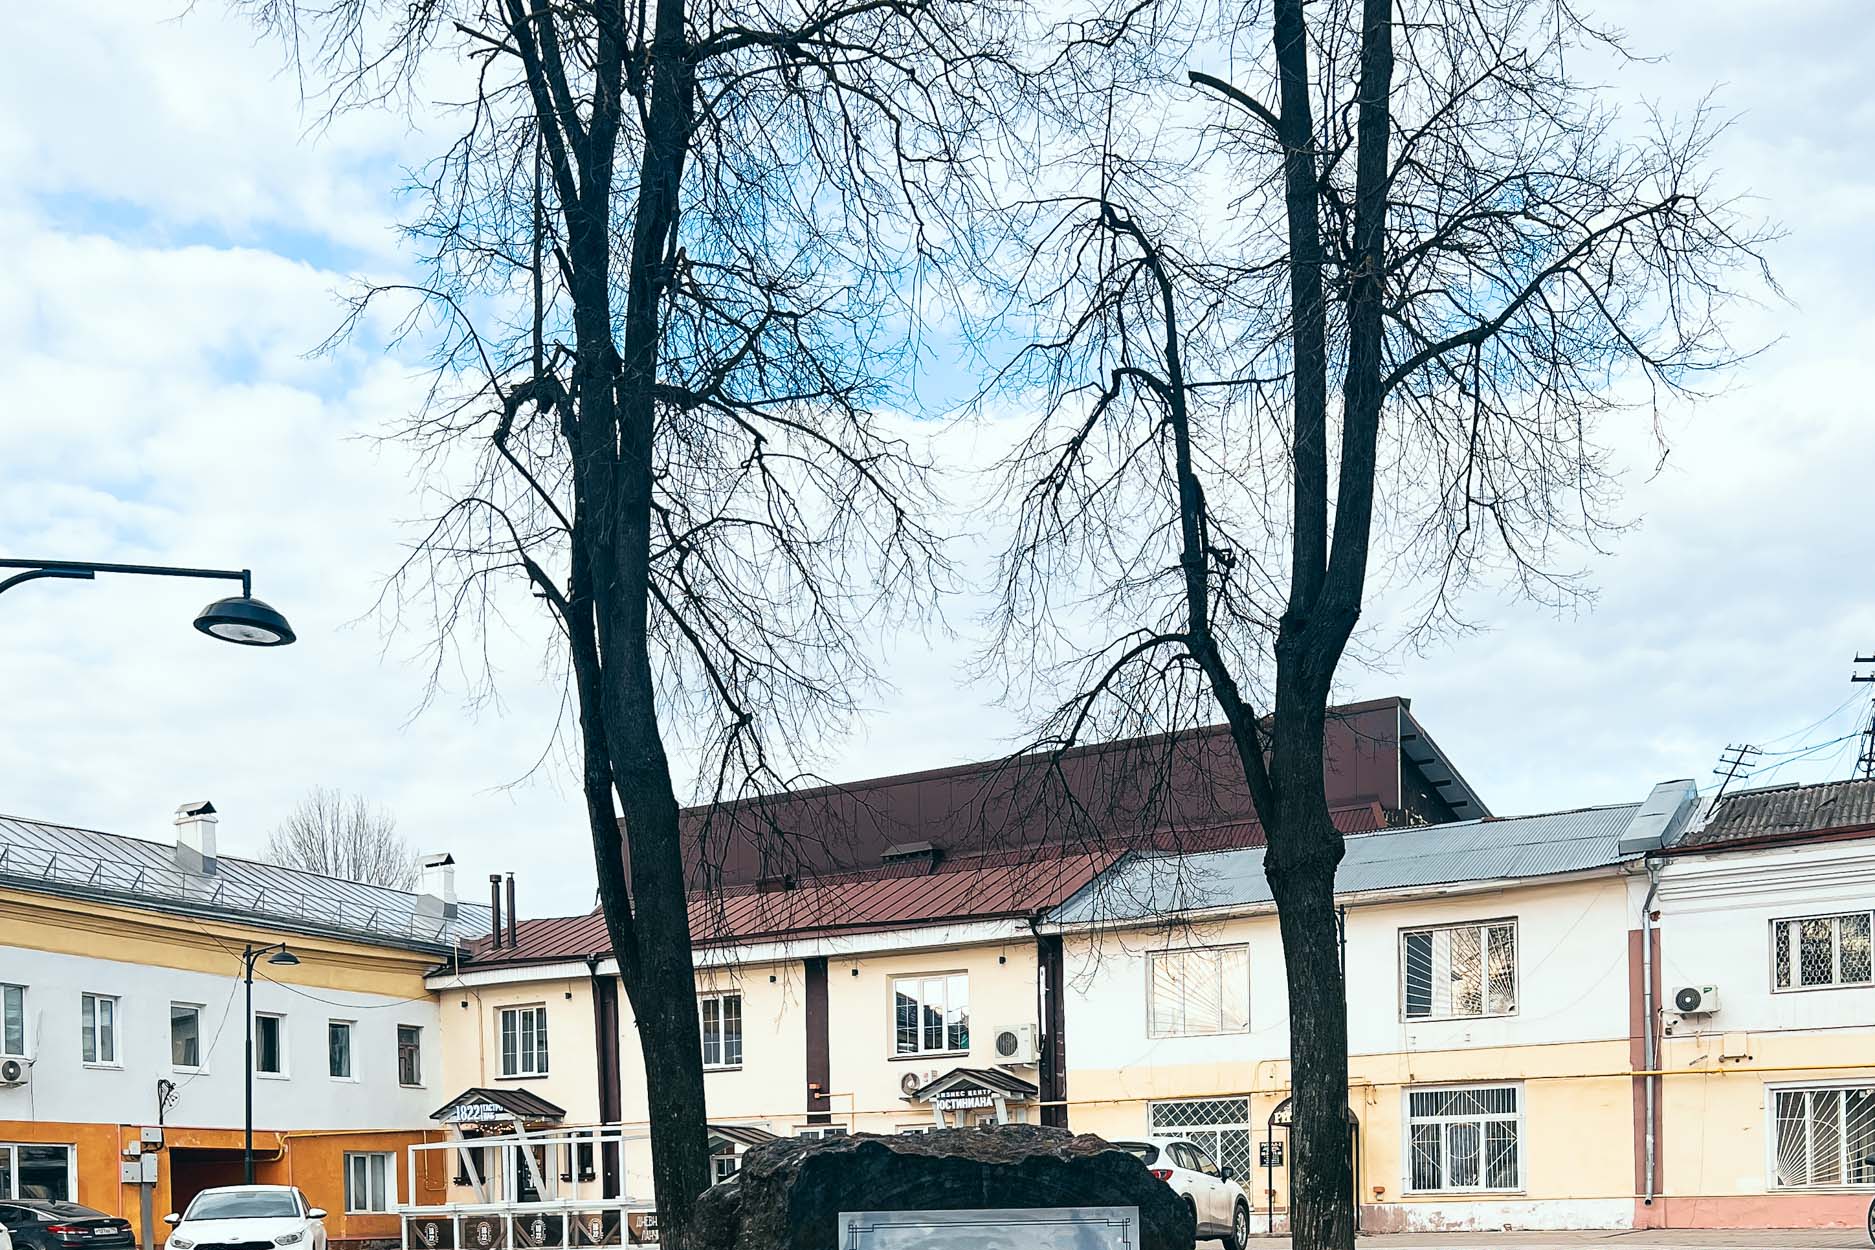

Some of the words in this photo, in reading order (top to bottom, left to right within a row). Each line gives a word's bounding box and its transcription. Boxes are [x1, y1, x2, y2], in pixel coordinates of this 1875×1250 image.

[936, 1096, 993, 1110] ЮСТИНИАНА
[456, 1104, 480, 1120] 1822
[636, 1215, 658, 1227] ДНЕВН
